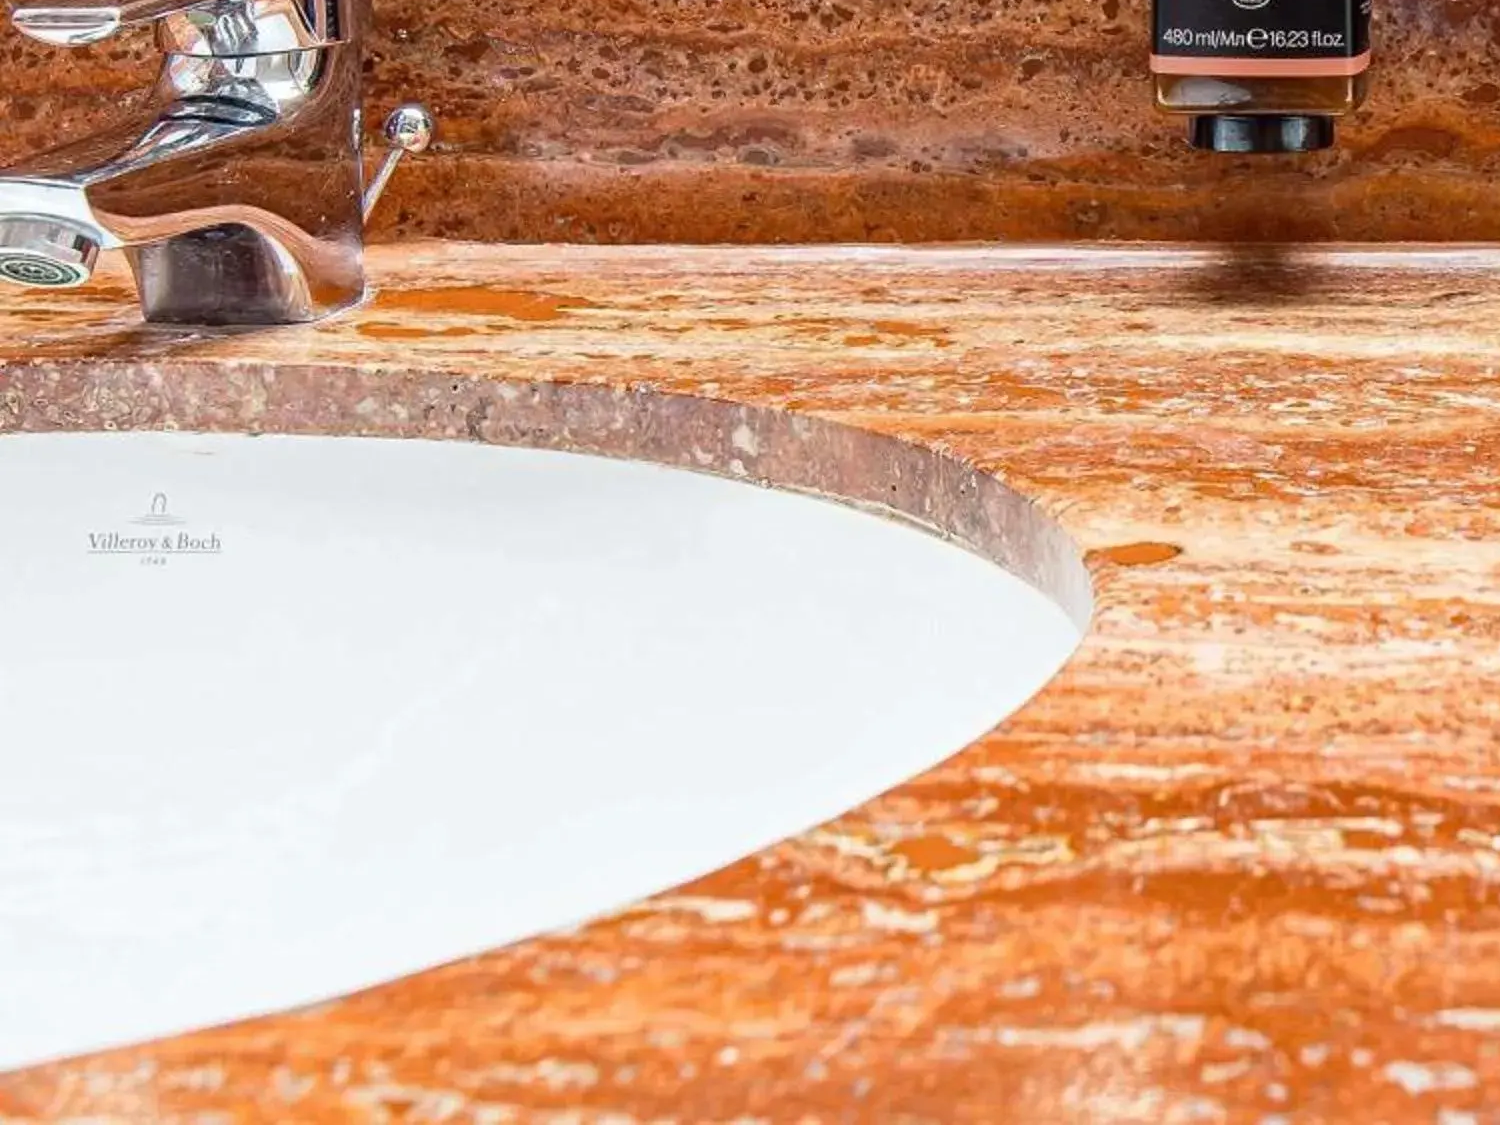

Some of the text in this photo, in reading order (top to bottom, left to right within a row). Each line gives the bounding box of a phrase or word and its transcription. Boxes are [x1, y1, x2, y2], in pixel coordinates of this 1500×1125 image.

[1163, 28, 1193, 46] 480
[88, 531, 221, 550] Villeroy & Boch
